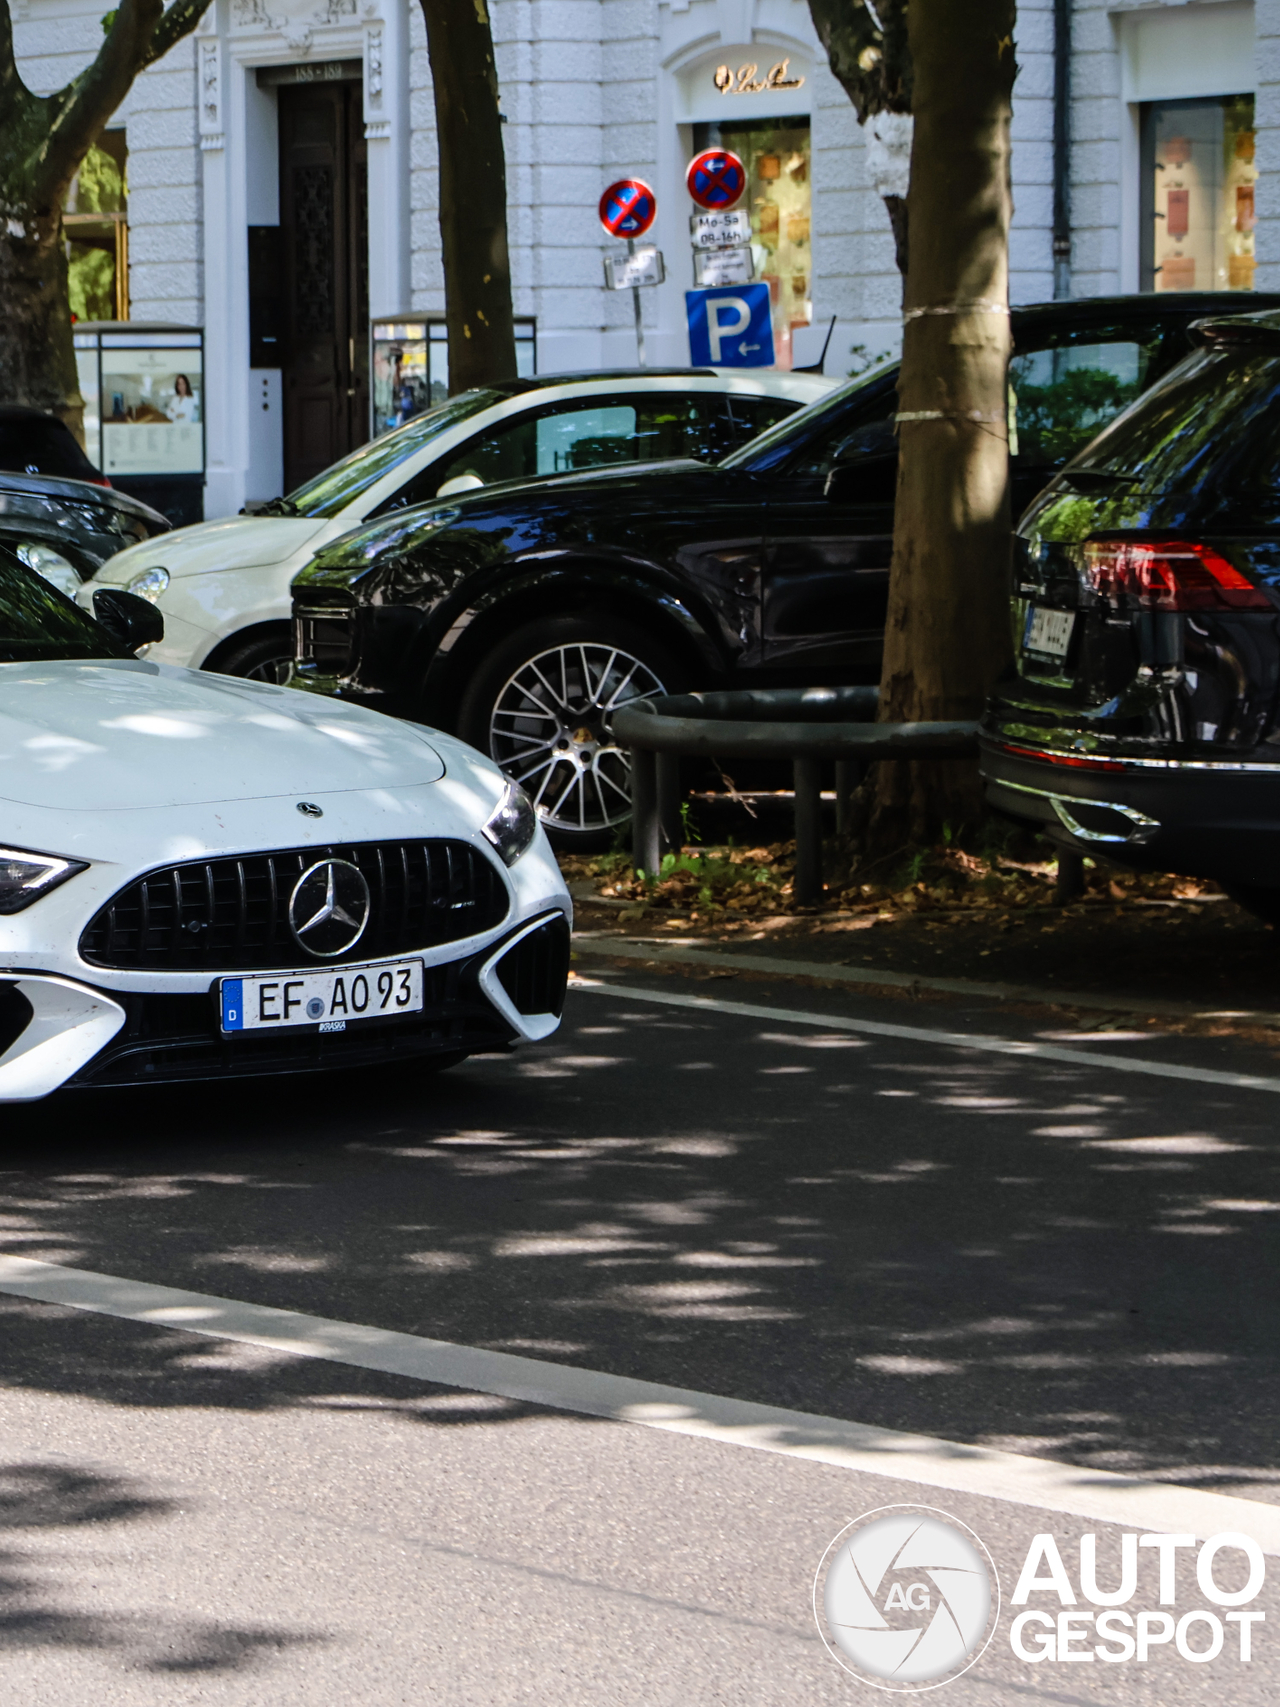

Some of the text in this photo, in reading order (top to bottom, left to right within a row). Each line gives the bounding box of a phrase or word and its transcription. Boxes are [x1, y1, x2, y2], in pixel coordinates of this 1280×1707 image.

[699, 215, 739, 228] Mo-Sa
[701, 231, 741, 245] 08-16h
[706, 297, 751, 362] P
[259, 981, 304, 1021] EF
[378, 969, 411, 1009] 93
[228, 1009, 237, 1021] D
